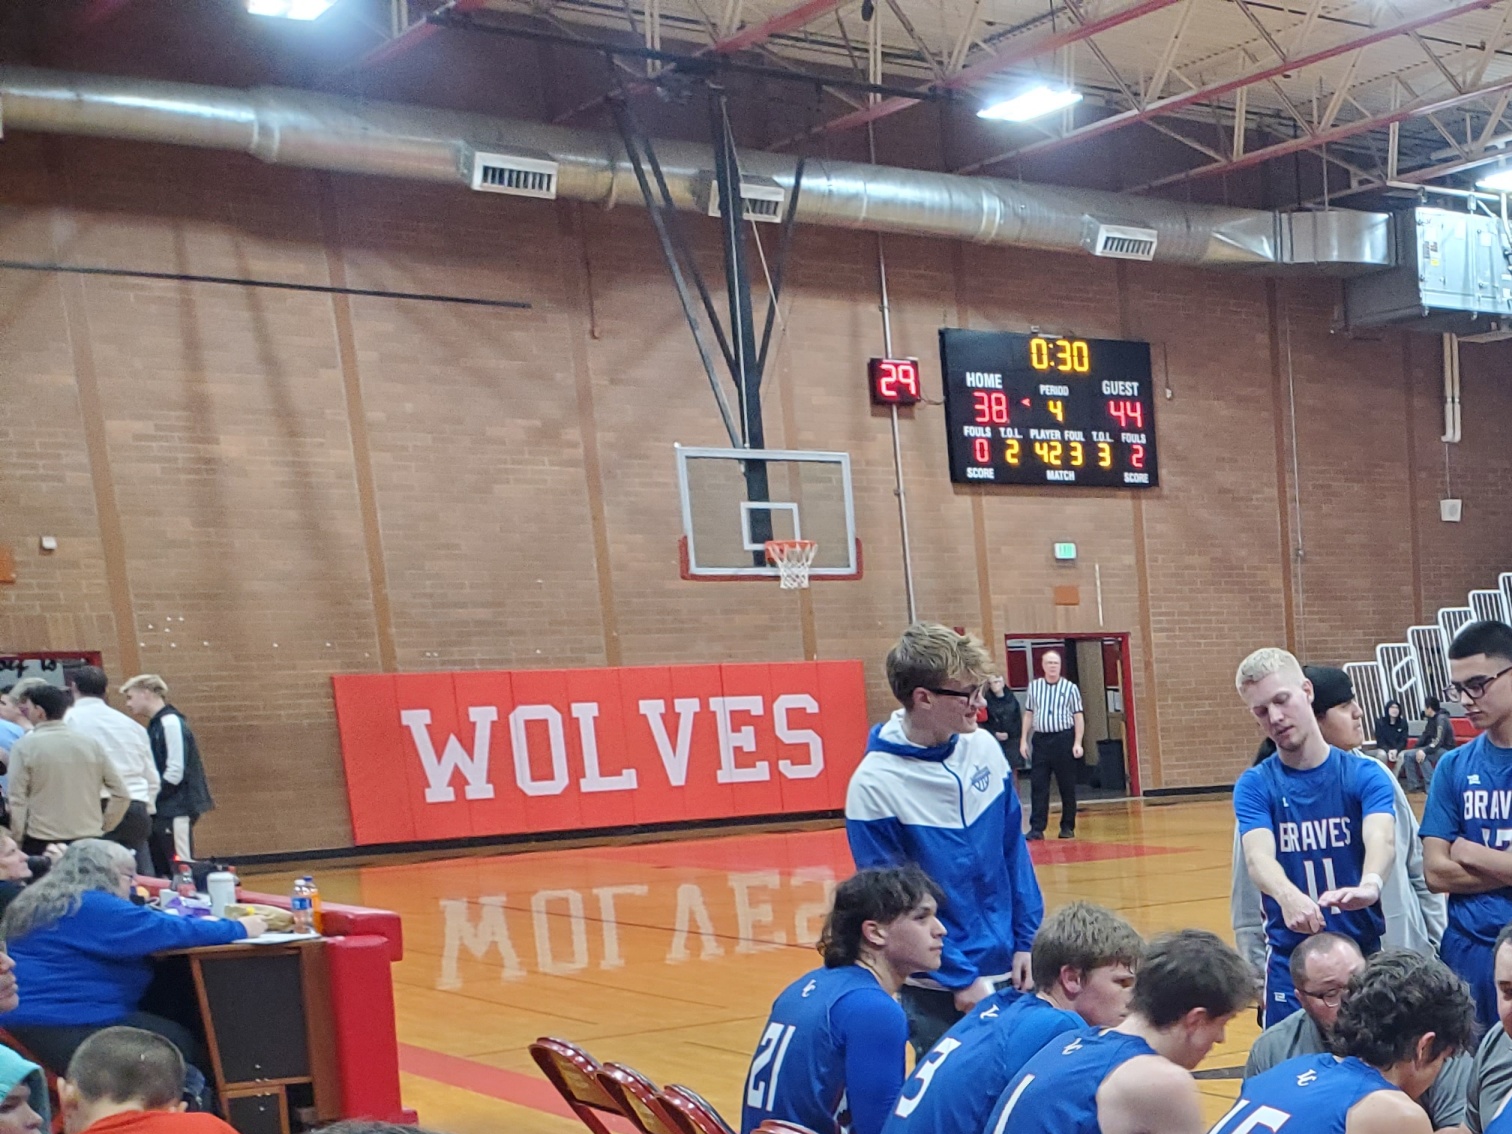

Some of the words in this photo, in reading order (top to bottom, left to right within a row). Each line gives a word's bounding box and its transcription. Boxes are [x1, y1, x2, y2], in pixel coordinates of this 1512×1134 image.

[1030, 338, 1089, 371] 0:30
[880, 363, 916, 396] 29
[966, 372, 1002, 389] HOME
[1040, 385, 1069, 396] PERIOD
[1102, 380, 1139, 396] GUEST
[973, 391, 1009, 423] 38
[1047, 400, 1064, 422] 4
[1109, 400, 1143, 428] 44
[964, 426, 991, 437] FOULS
[1030, 429, 1061, 440] PLAYER
[1064, 430, 1085, 441] FOUL
[1121, 432, 1146, 443] FOULS
[975, 439, 989, 462] 0
[1005, 440, 1019, 463] 2
[1034, 441, 1061, 465] 42
[1070, 441, 1083, 465] 3
[1098, 442, 1111, 466] 3
[1132, 445, 1144, 467] 2
[967, 468, 994, 479] SCORE
[1046, 470, 1075, 481] MATCH
[1124, 472, 1149, 483] SCORE
[400, 694, 825, 803] WOLVES
[1280, 817, 1351, 852] BRAVES
[1303, 858, 1342, 915] 11
[747, 1022, 796, 1112] 21
